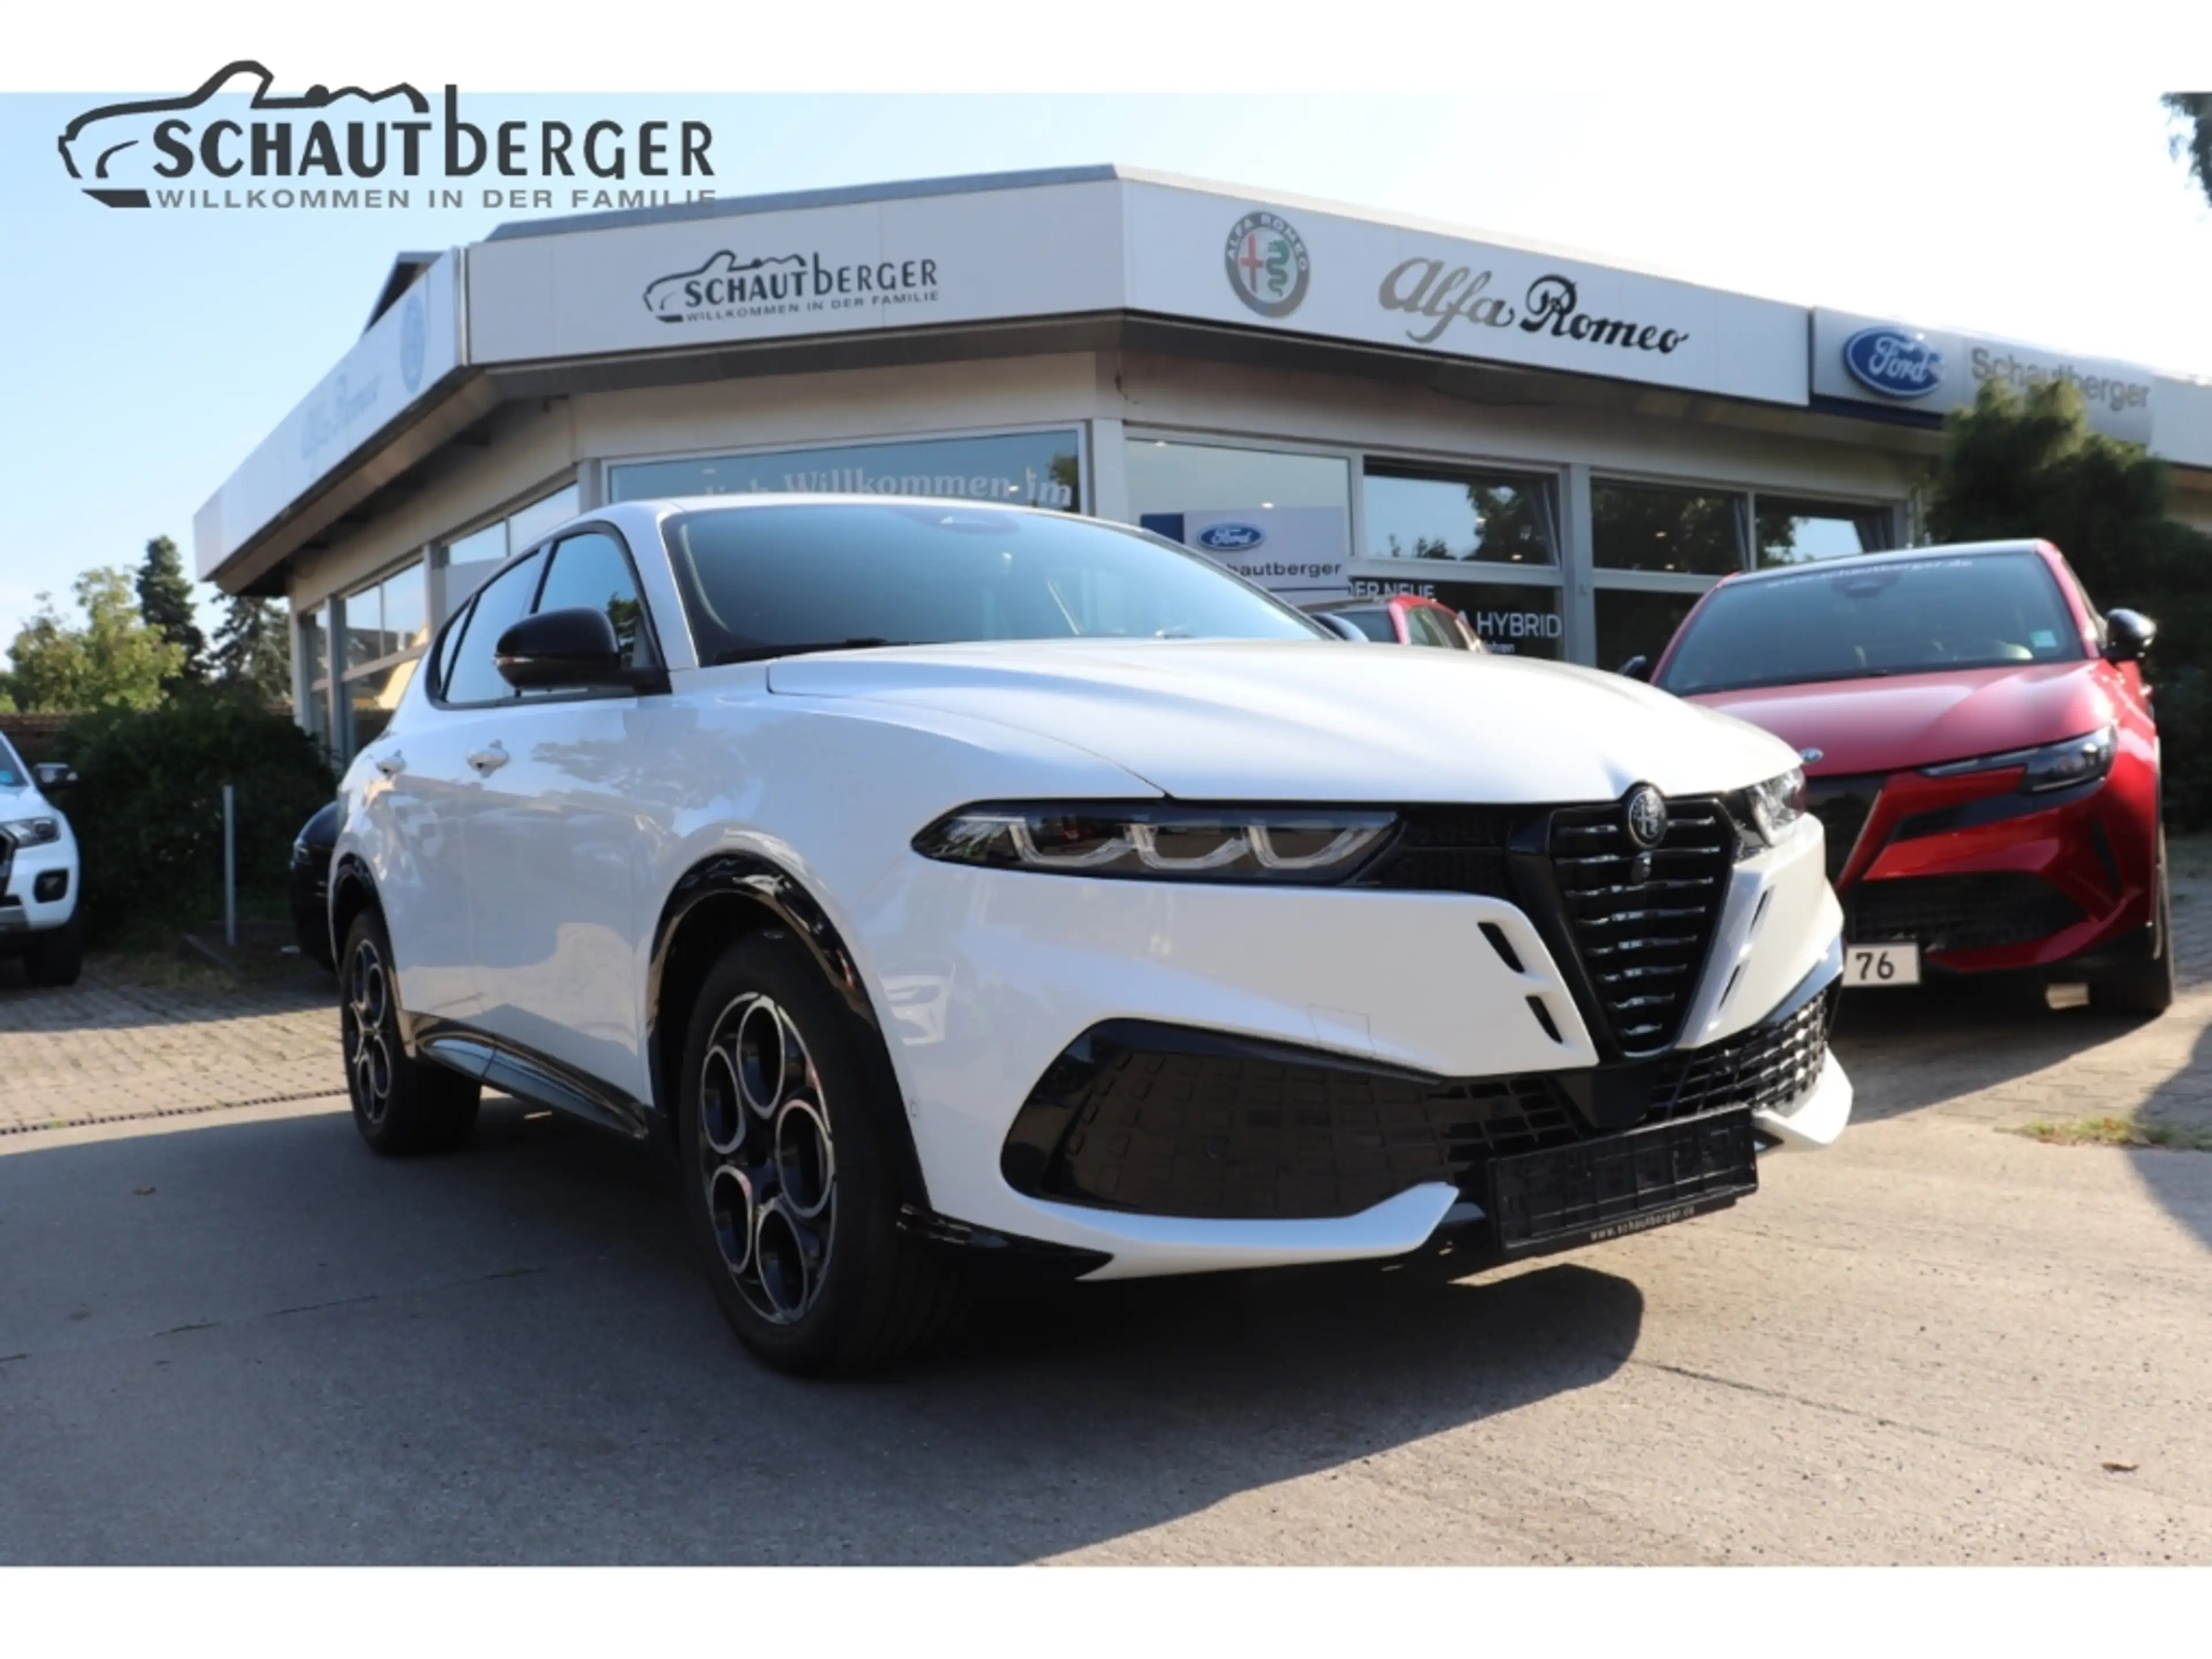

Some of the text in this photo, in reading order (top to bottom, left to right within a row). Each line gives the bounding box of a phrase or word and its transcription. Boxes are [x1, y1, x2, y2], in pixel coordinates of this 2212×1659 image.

[686, 290, 940, 323] WILLKOMMEN IN DER FAMILIE
[1378, 256, 1690, 355] Alfa Romeo
[1869, 336, 1930, 384] Ford
[783, 468, 1010, 498] Willkommen
[1211, 528, 1253, 546] Ford
[1477, 611, 1563, 638] HYBRID
[1855, 950, 1895, 980] 76
